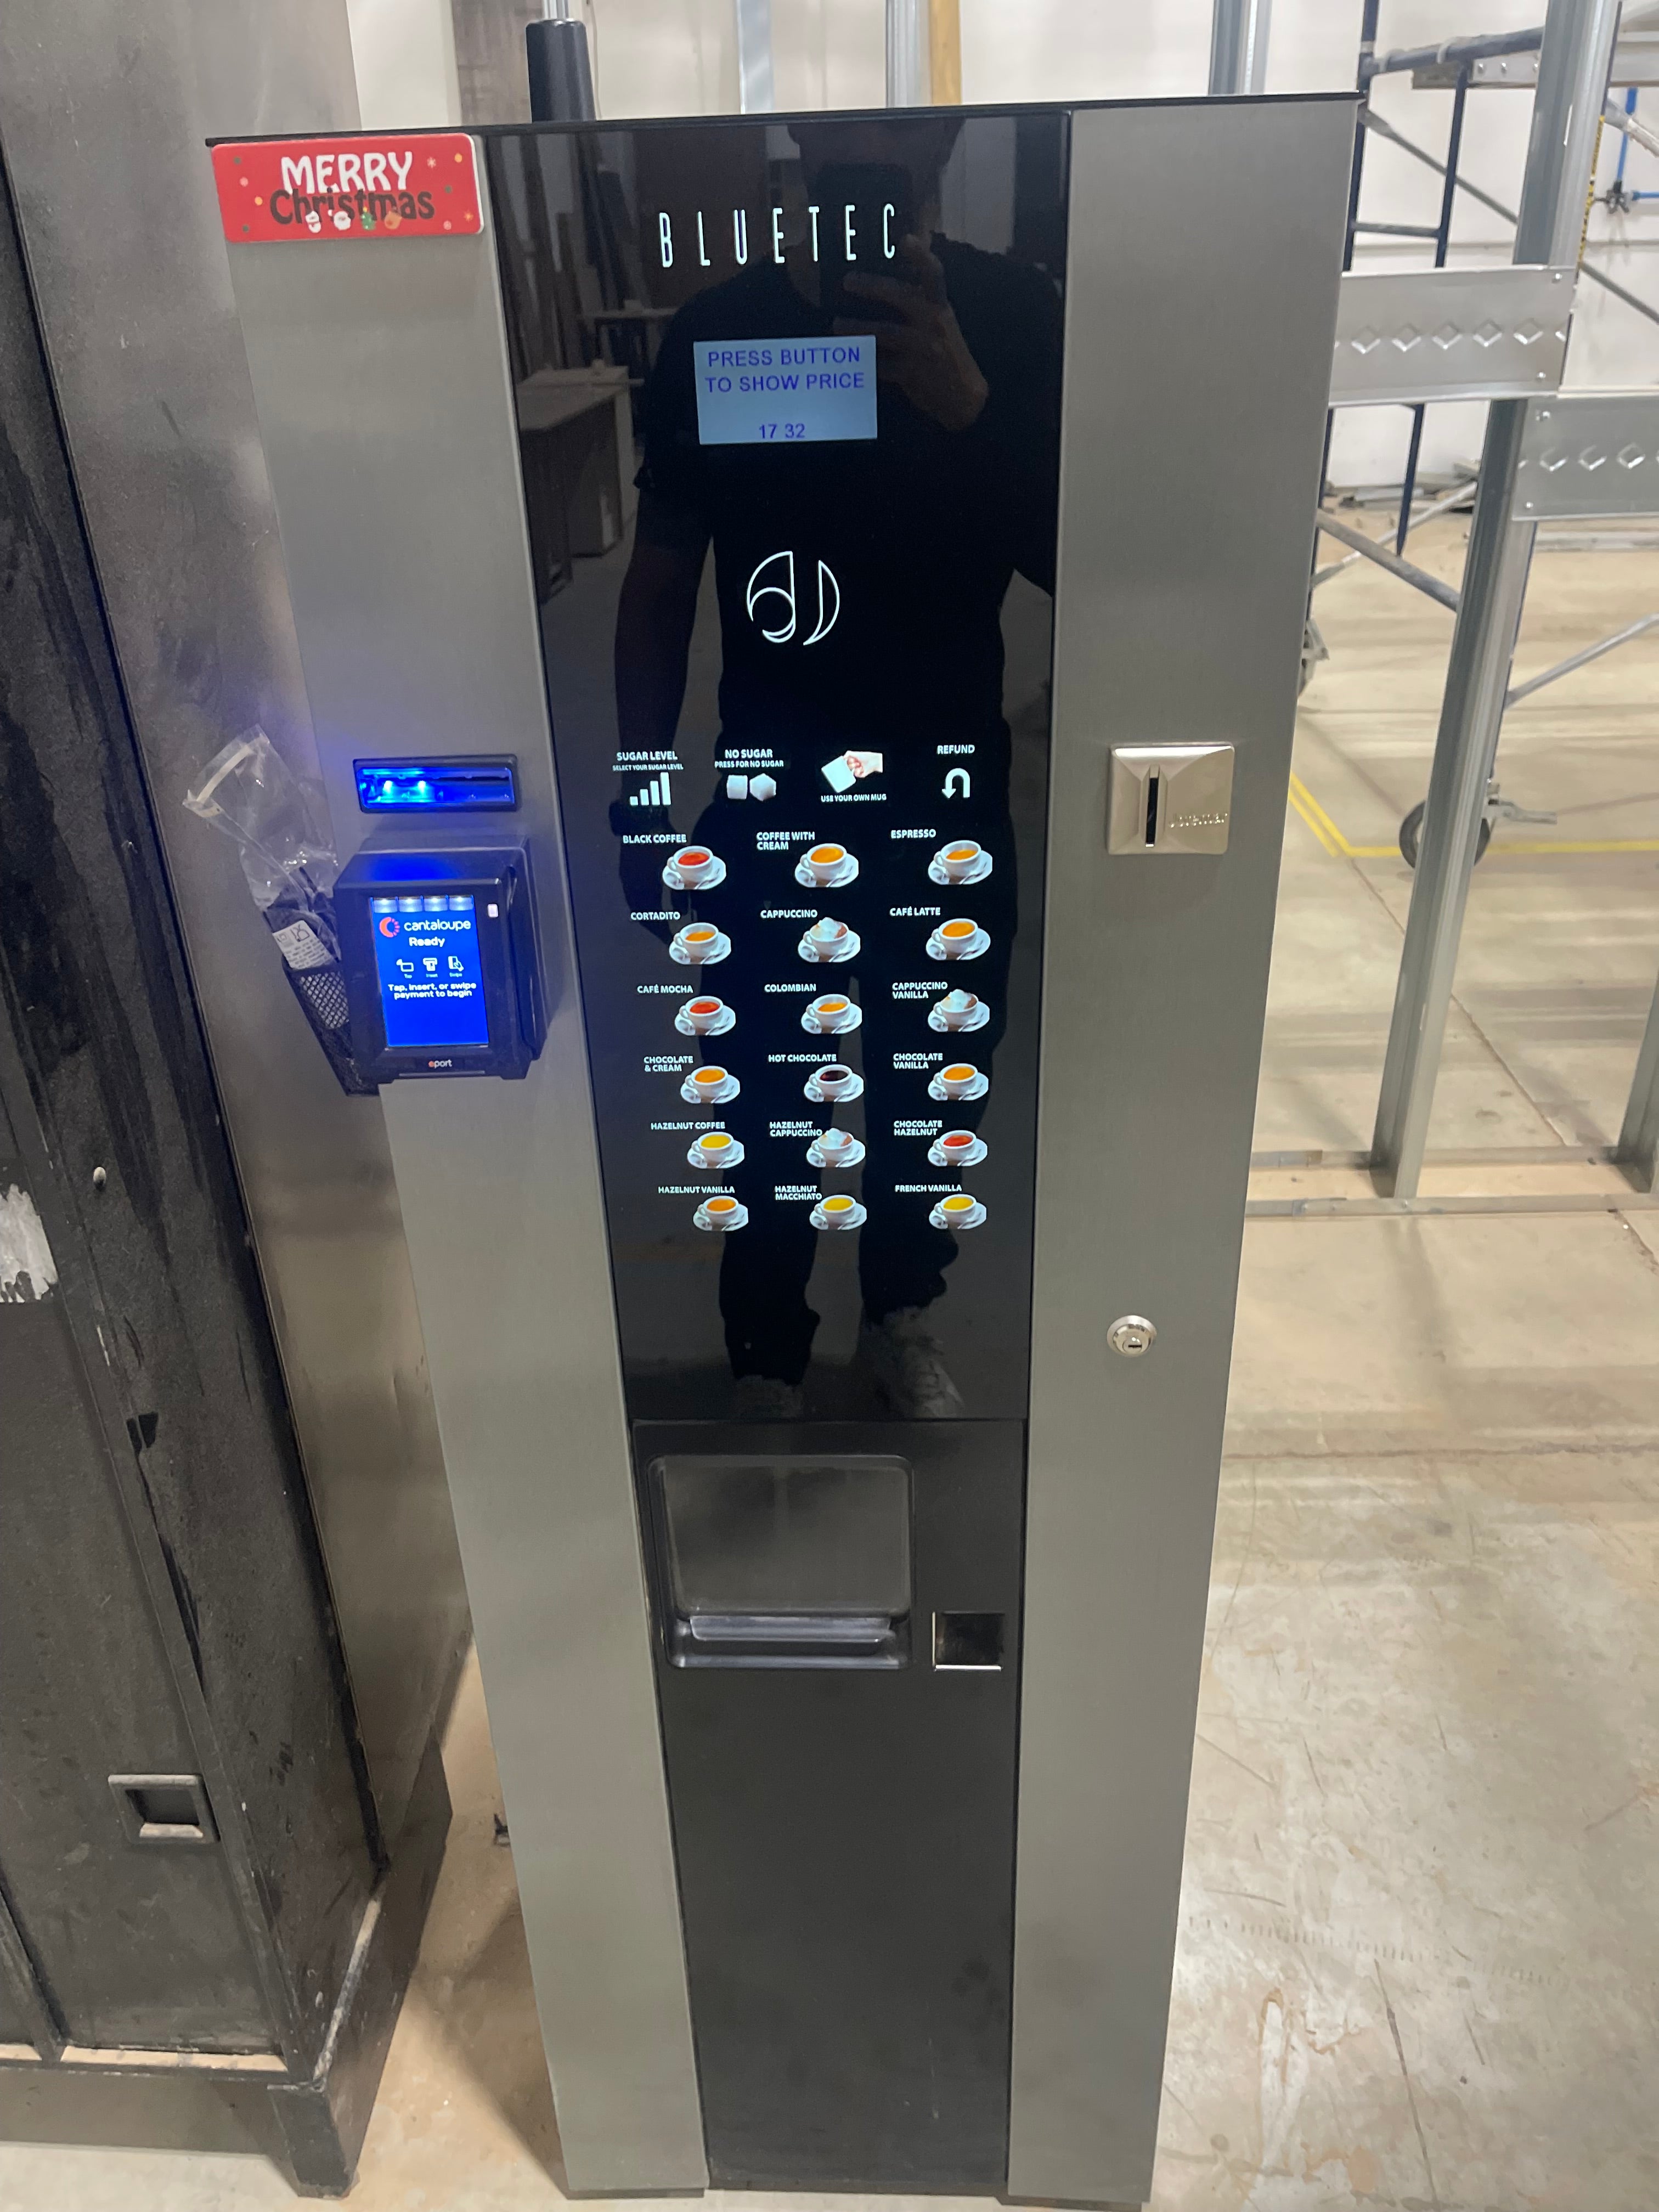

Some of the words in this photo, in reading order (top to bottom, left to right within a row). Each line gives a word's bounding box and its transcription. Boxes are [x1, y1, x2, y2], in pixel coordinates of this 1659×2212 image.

[280, 150, 413, 195] MERRY
[269, 185, 436, 225] Christmas
[659, 203, 895, 268] BLUETEC
[708, 350, 772, 368] PRESS
[780, 346, 861, 366] BUTTON
[704, 376, 732, 393] TO
[738, 374, 800, 392] SHOW
[806, 372, 865, 390] PRICE
[758, 424, 778, 439] 17
[785, 423, 806, 438] 32
[725, 749, 740, 759] NO
[741, 748, 773, 759] SUGAR
[936, 744, 975, 755] REFUND
[616, 752, 649, 761] SUGAR
[650, 751, 678, 761] LEVEL
[821, 794, 834, 803] USE
[834, 794, 853, 802] YOUR
[623, 834, 652, 844] BLACK
[653, 833, 687, 843] COFFEE
[756, 831, 791, 841] COFFEE
[791, 831, 815, 840] WITH
[890, 828, 936, 839] ESPRESSO
[757, 842, 789, 851] CREAM
[630, 911, 681, 921] CORTADITO
[760, 909, 818, 919] CAPPUCCINO
[889, 906, 913, 917] CAFÉ
[914, 907, 941, 916] LATTE
[404, 918, 471, 932] cantaloupe
[409, 936, 445, 947] Ready
[450, 981, 477, 990] swipe
[637, 984, 659, 994] CAFÉ
[660, 985, 694, 994] MOCHA
[764, 984, 816, 992] COLOMBIAN
[892, 981, 948, 990] CAPPUCCINO
[393, 990, 435, 1000] payment
[447, 989, 472, 998] begin
[892, 990, 929, 999] VANILLA
[644, 1056, 694, 1064] CHOCOLATE
[768, 1054, 786, 1062] HOT
[787, 1053, 837, 1062] CHOCOLATE
[893, 1053, 943, 1061] CHOCOLATE
[652, 1064, 682, 1072] CREAM
[893, 1061, 929, 1069] VANILLA
[650, 1122, 695, 1130] HAZELNUT
[695, 1121, 726, 1130] COFFEE
[769, 1121, 813, 1129] HAZELNUT
[893, 1120, 943, 1128] CHOCOLATE
[770, 1129, 823, 1137] CAPPUCCINO
[894, 1128, 938, 1136] HAZELNUT
[658, 1186, 701, 1194] HAZELNUT
[701, 1186, 735, 1194] VANILLA
[928, 1184, 962, 1192] VANILLA
